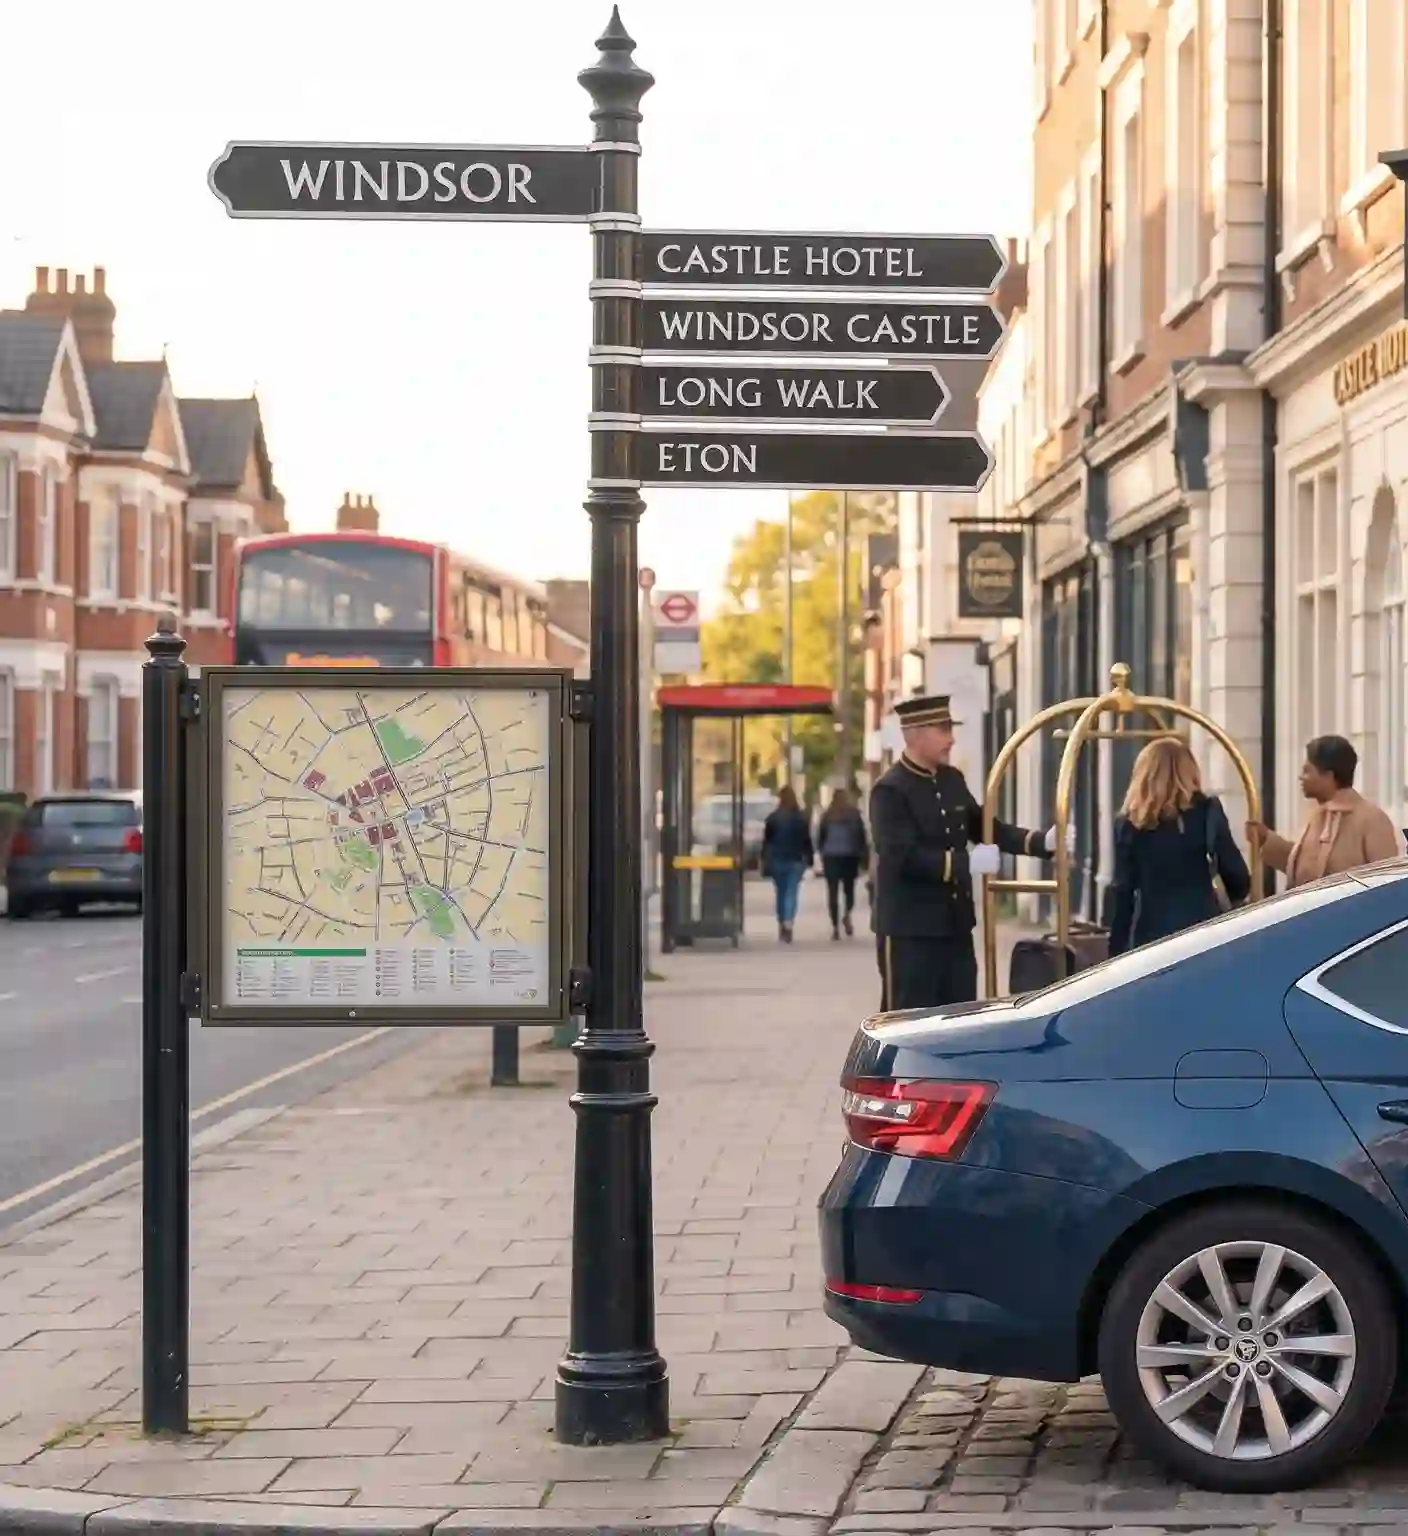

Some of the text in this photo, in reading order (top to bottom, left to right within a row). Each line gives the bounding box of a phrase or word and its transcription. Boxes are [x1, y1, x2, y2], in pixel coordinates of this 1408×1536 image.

[279, 159, 538, 205] WINDSOR
[657, 244, 924, 278] CASTLE HOTEL
[658, 311, 981, 345] WINDSOR CASTLE
[658, 377, 880, 410] LONG WALK
[658, 443, 758, 474] ETON
